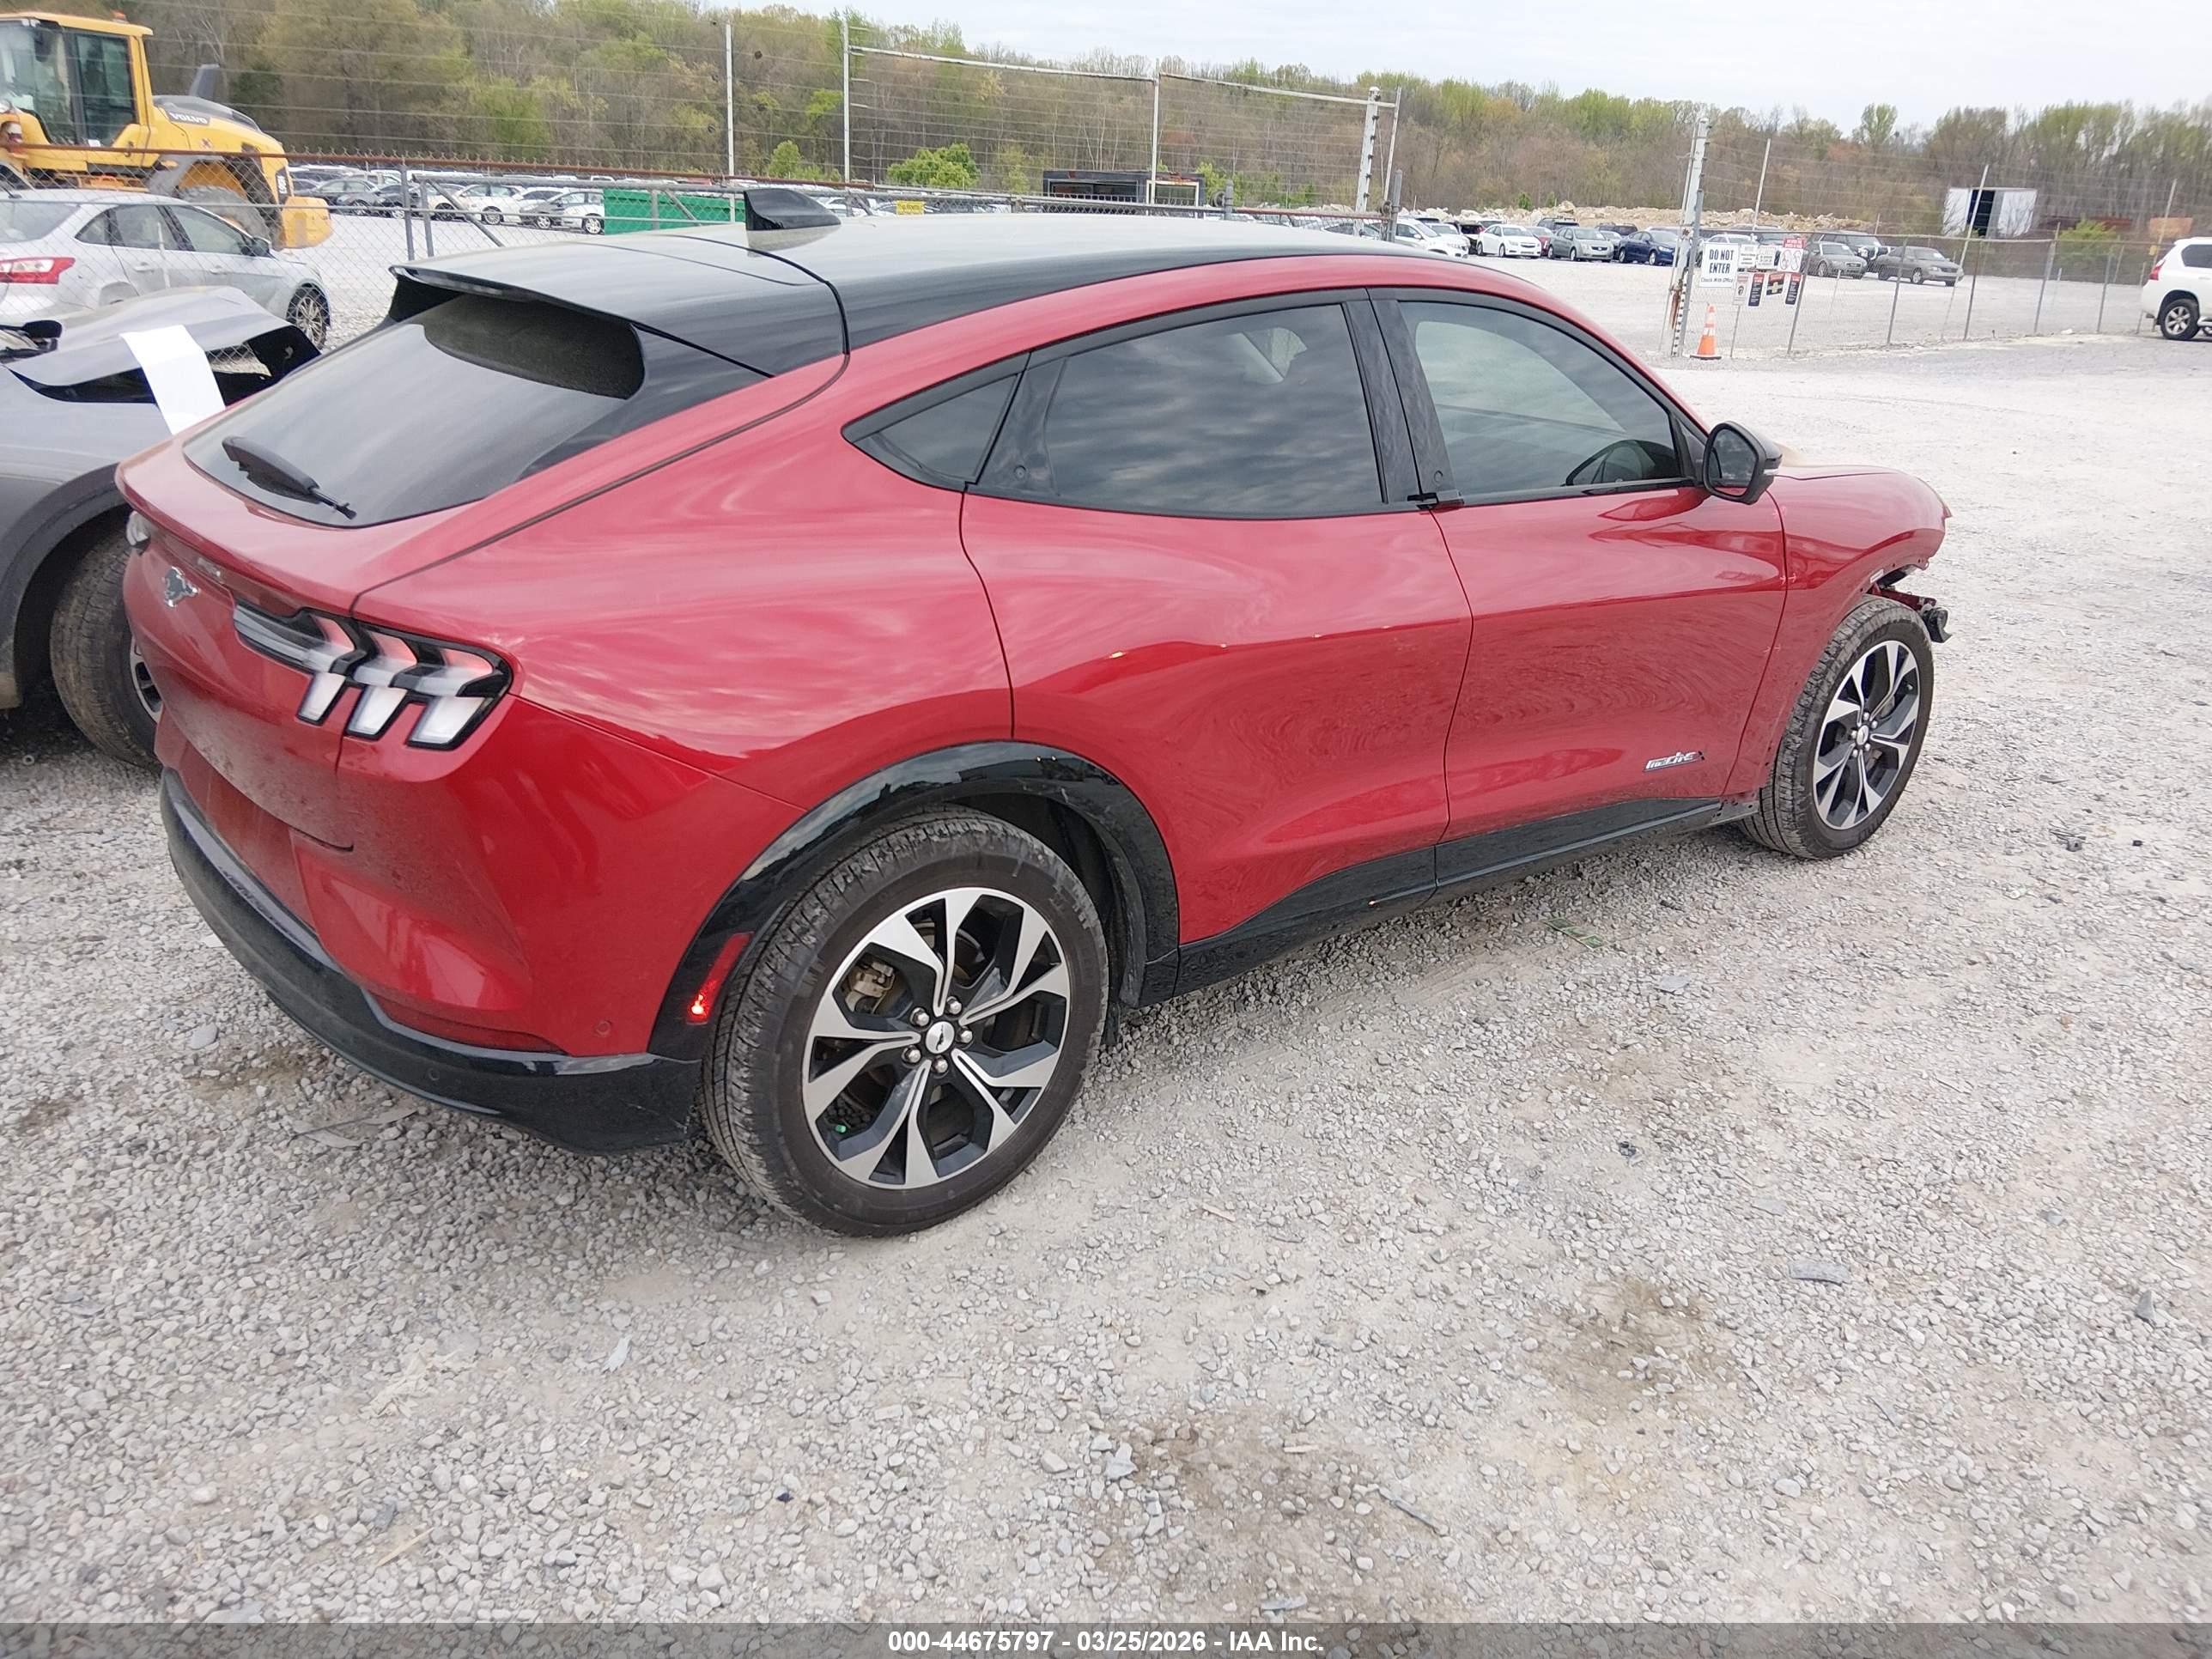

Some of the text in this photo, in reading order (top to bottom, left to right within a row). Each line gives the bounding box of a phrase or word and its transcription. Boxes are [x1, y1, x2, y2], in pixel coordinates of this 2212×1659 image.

[169, 112, 208, 125] VOLVO
[1709, 249, 1719, 260] DO
[1720, 249, 1734, 260] NOT
[1709, 263, 1730, 274] ENTER
